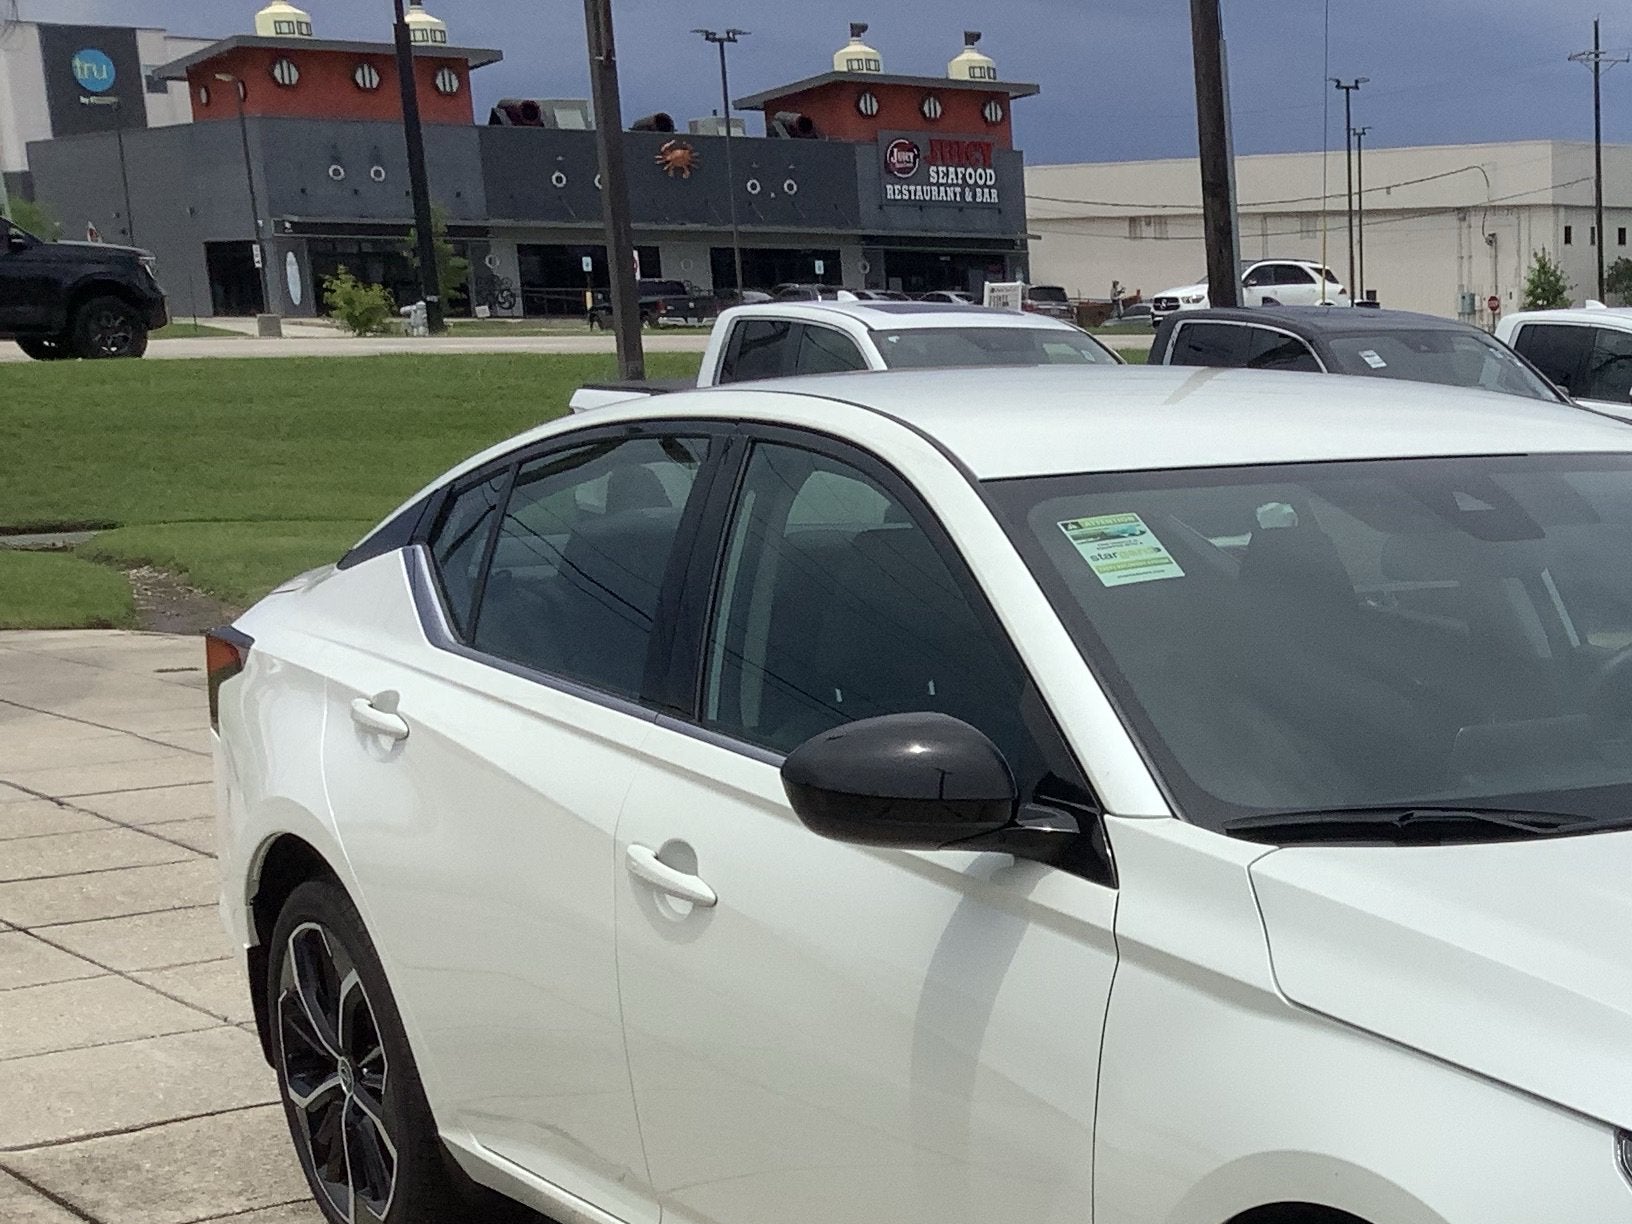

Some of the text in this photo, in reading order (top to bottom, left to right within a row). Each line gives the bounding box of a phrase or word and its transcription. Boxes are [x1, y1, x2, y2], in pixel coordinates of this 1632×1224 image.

[73, 58, 107, 80] tru
[929, 166, 996, 186] SEAFOOD
[886, 185, 999, 203] RESTAURANT & BAR
